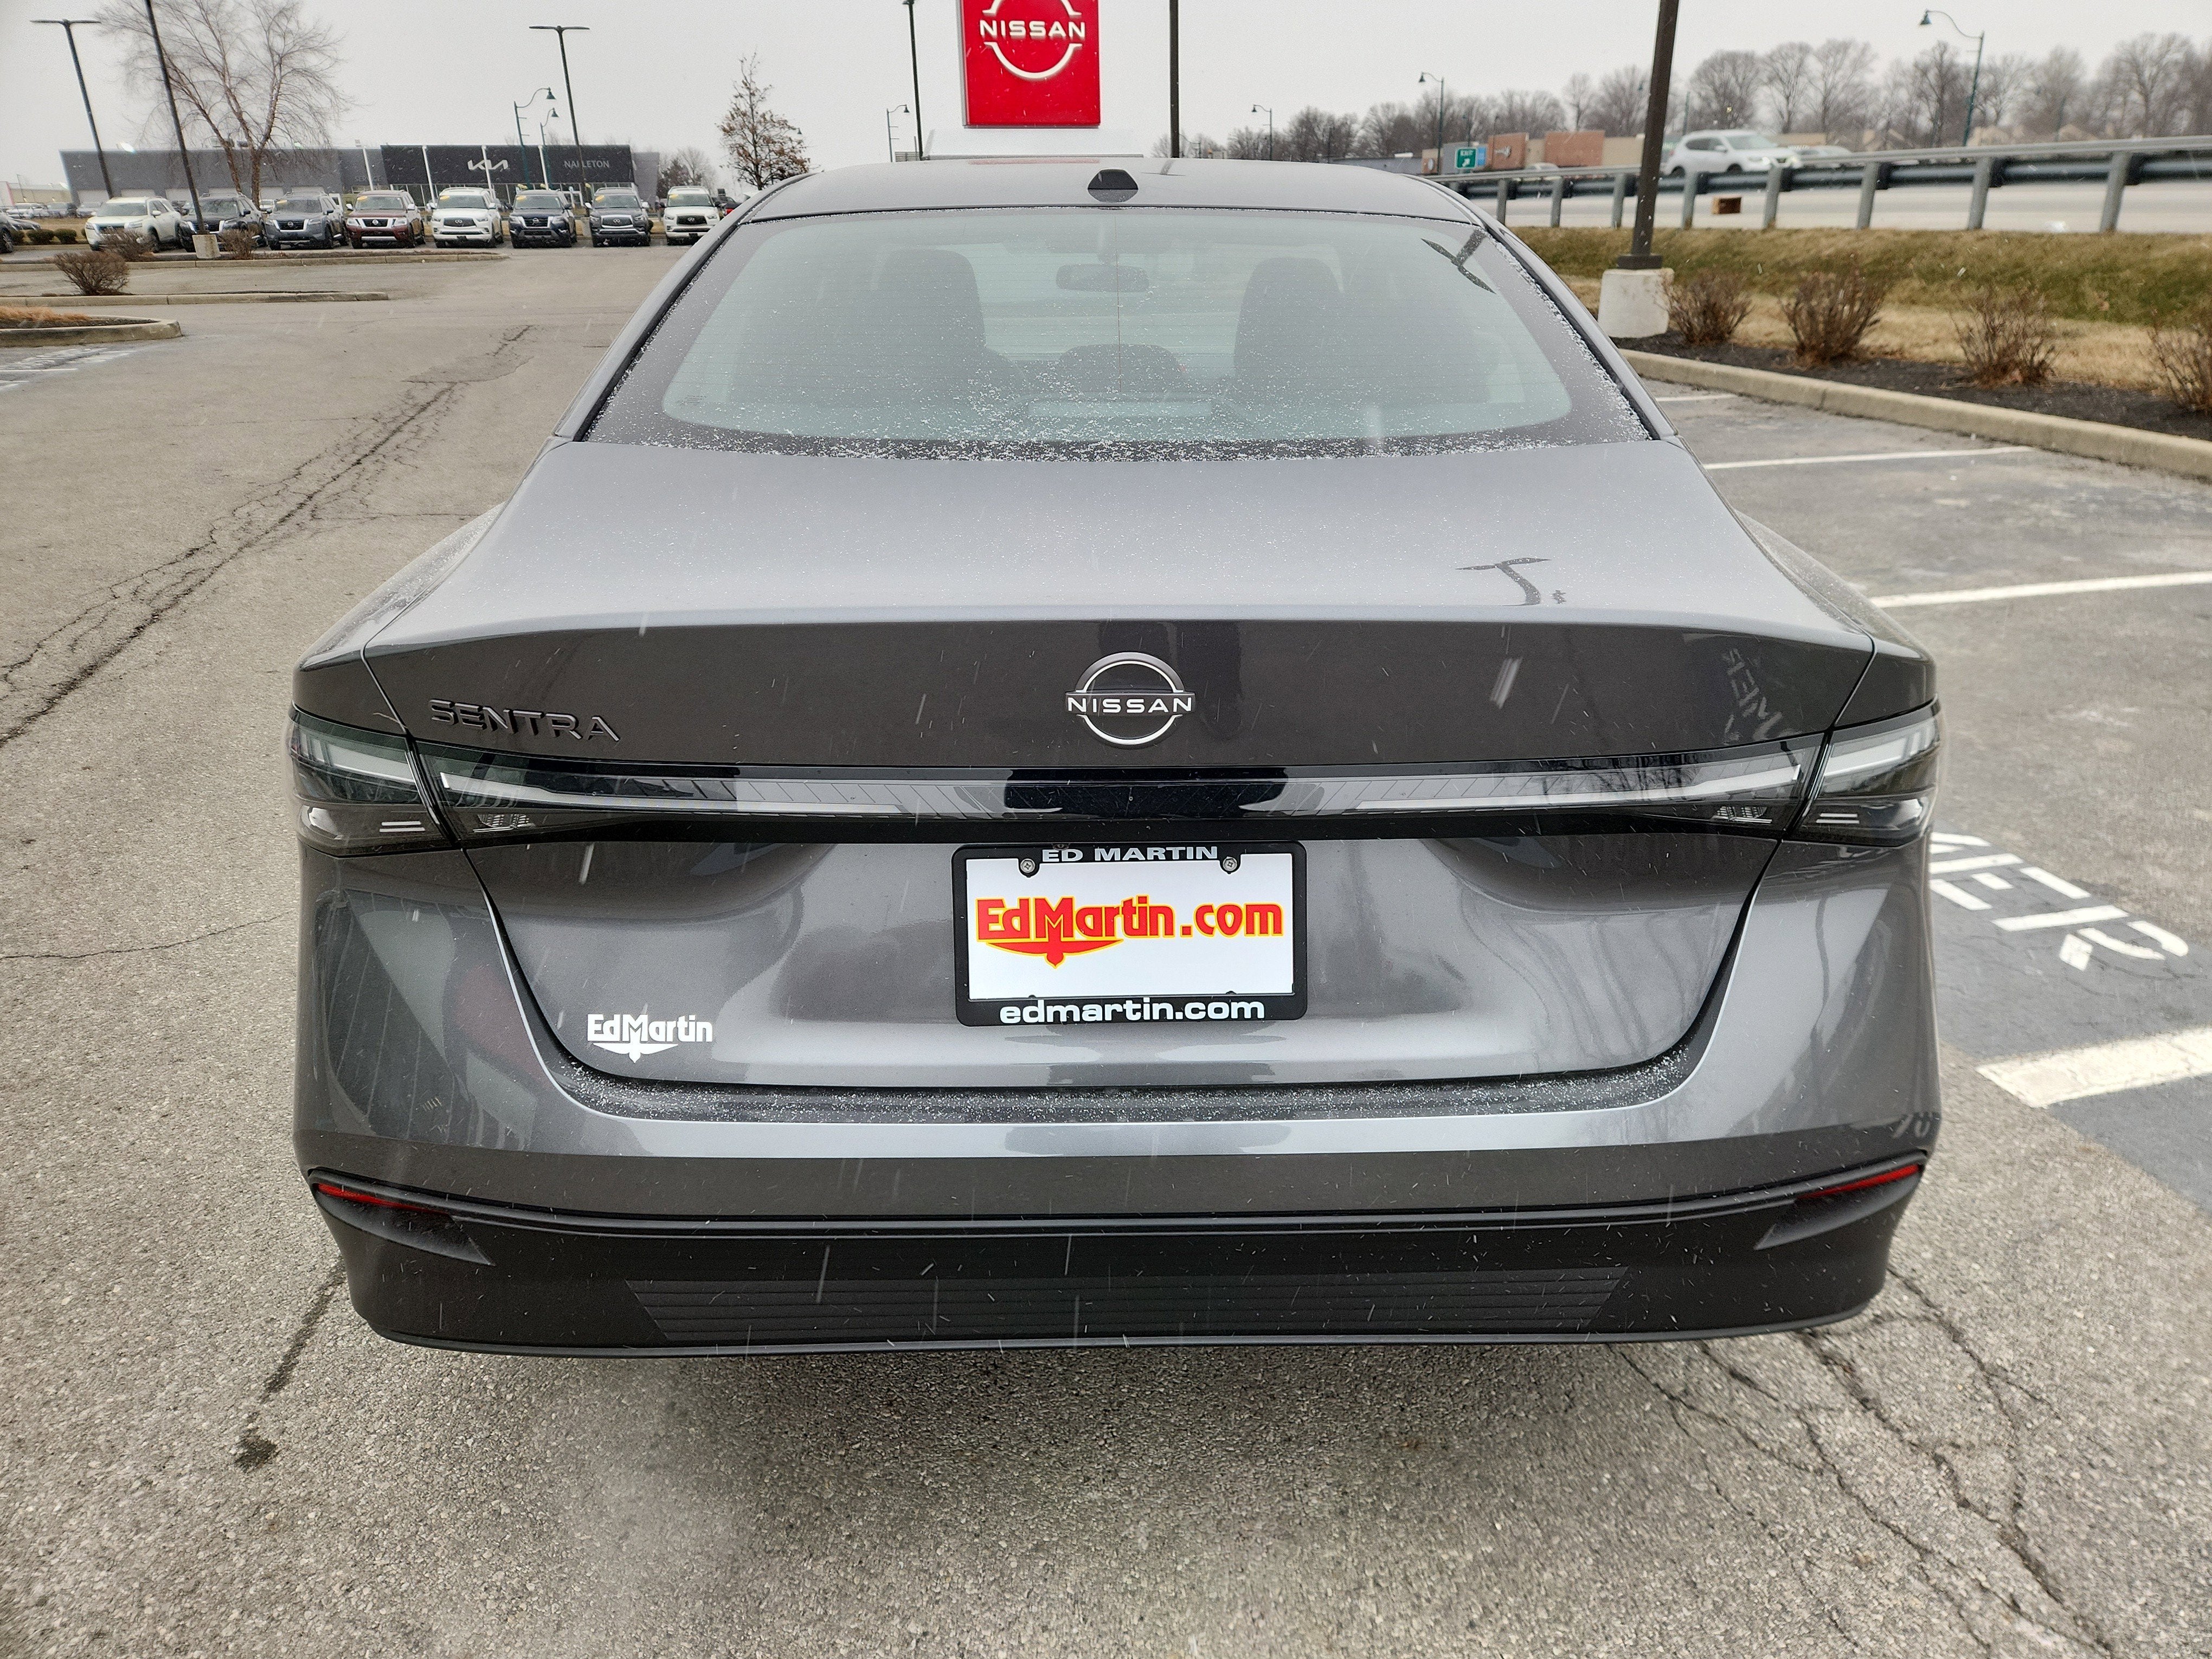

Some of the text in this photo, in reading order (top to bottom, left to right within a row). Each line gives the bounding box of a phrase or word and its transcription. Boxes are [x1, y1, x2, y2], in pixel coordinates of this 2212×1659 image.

[980, 20, 1085, 37] NISSAN
[1068, 697, 1192, 713] NISSAN
[429, 699, 620, 741] SENTRA
[1042, 846, 1218, 862] ED MARTIN
[1000, 997, 1265, 1024] edmartin.com
[587, 1013, 713, 1043] EdMartin
